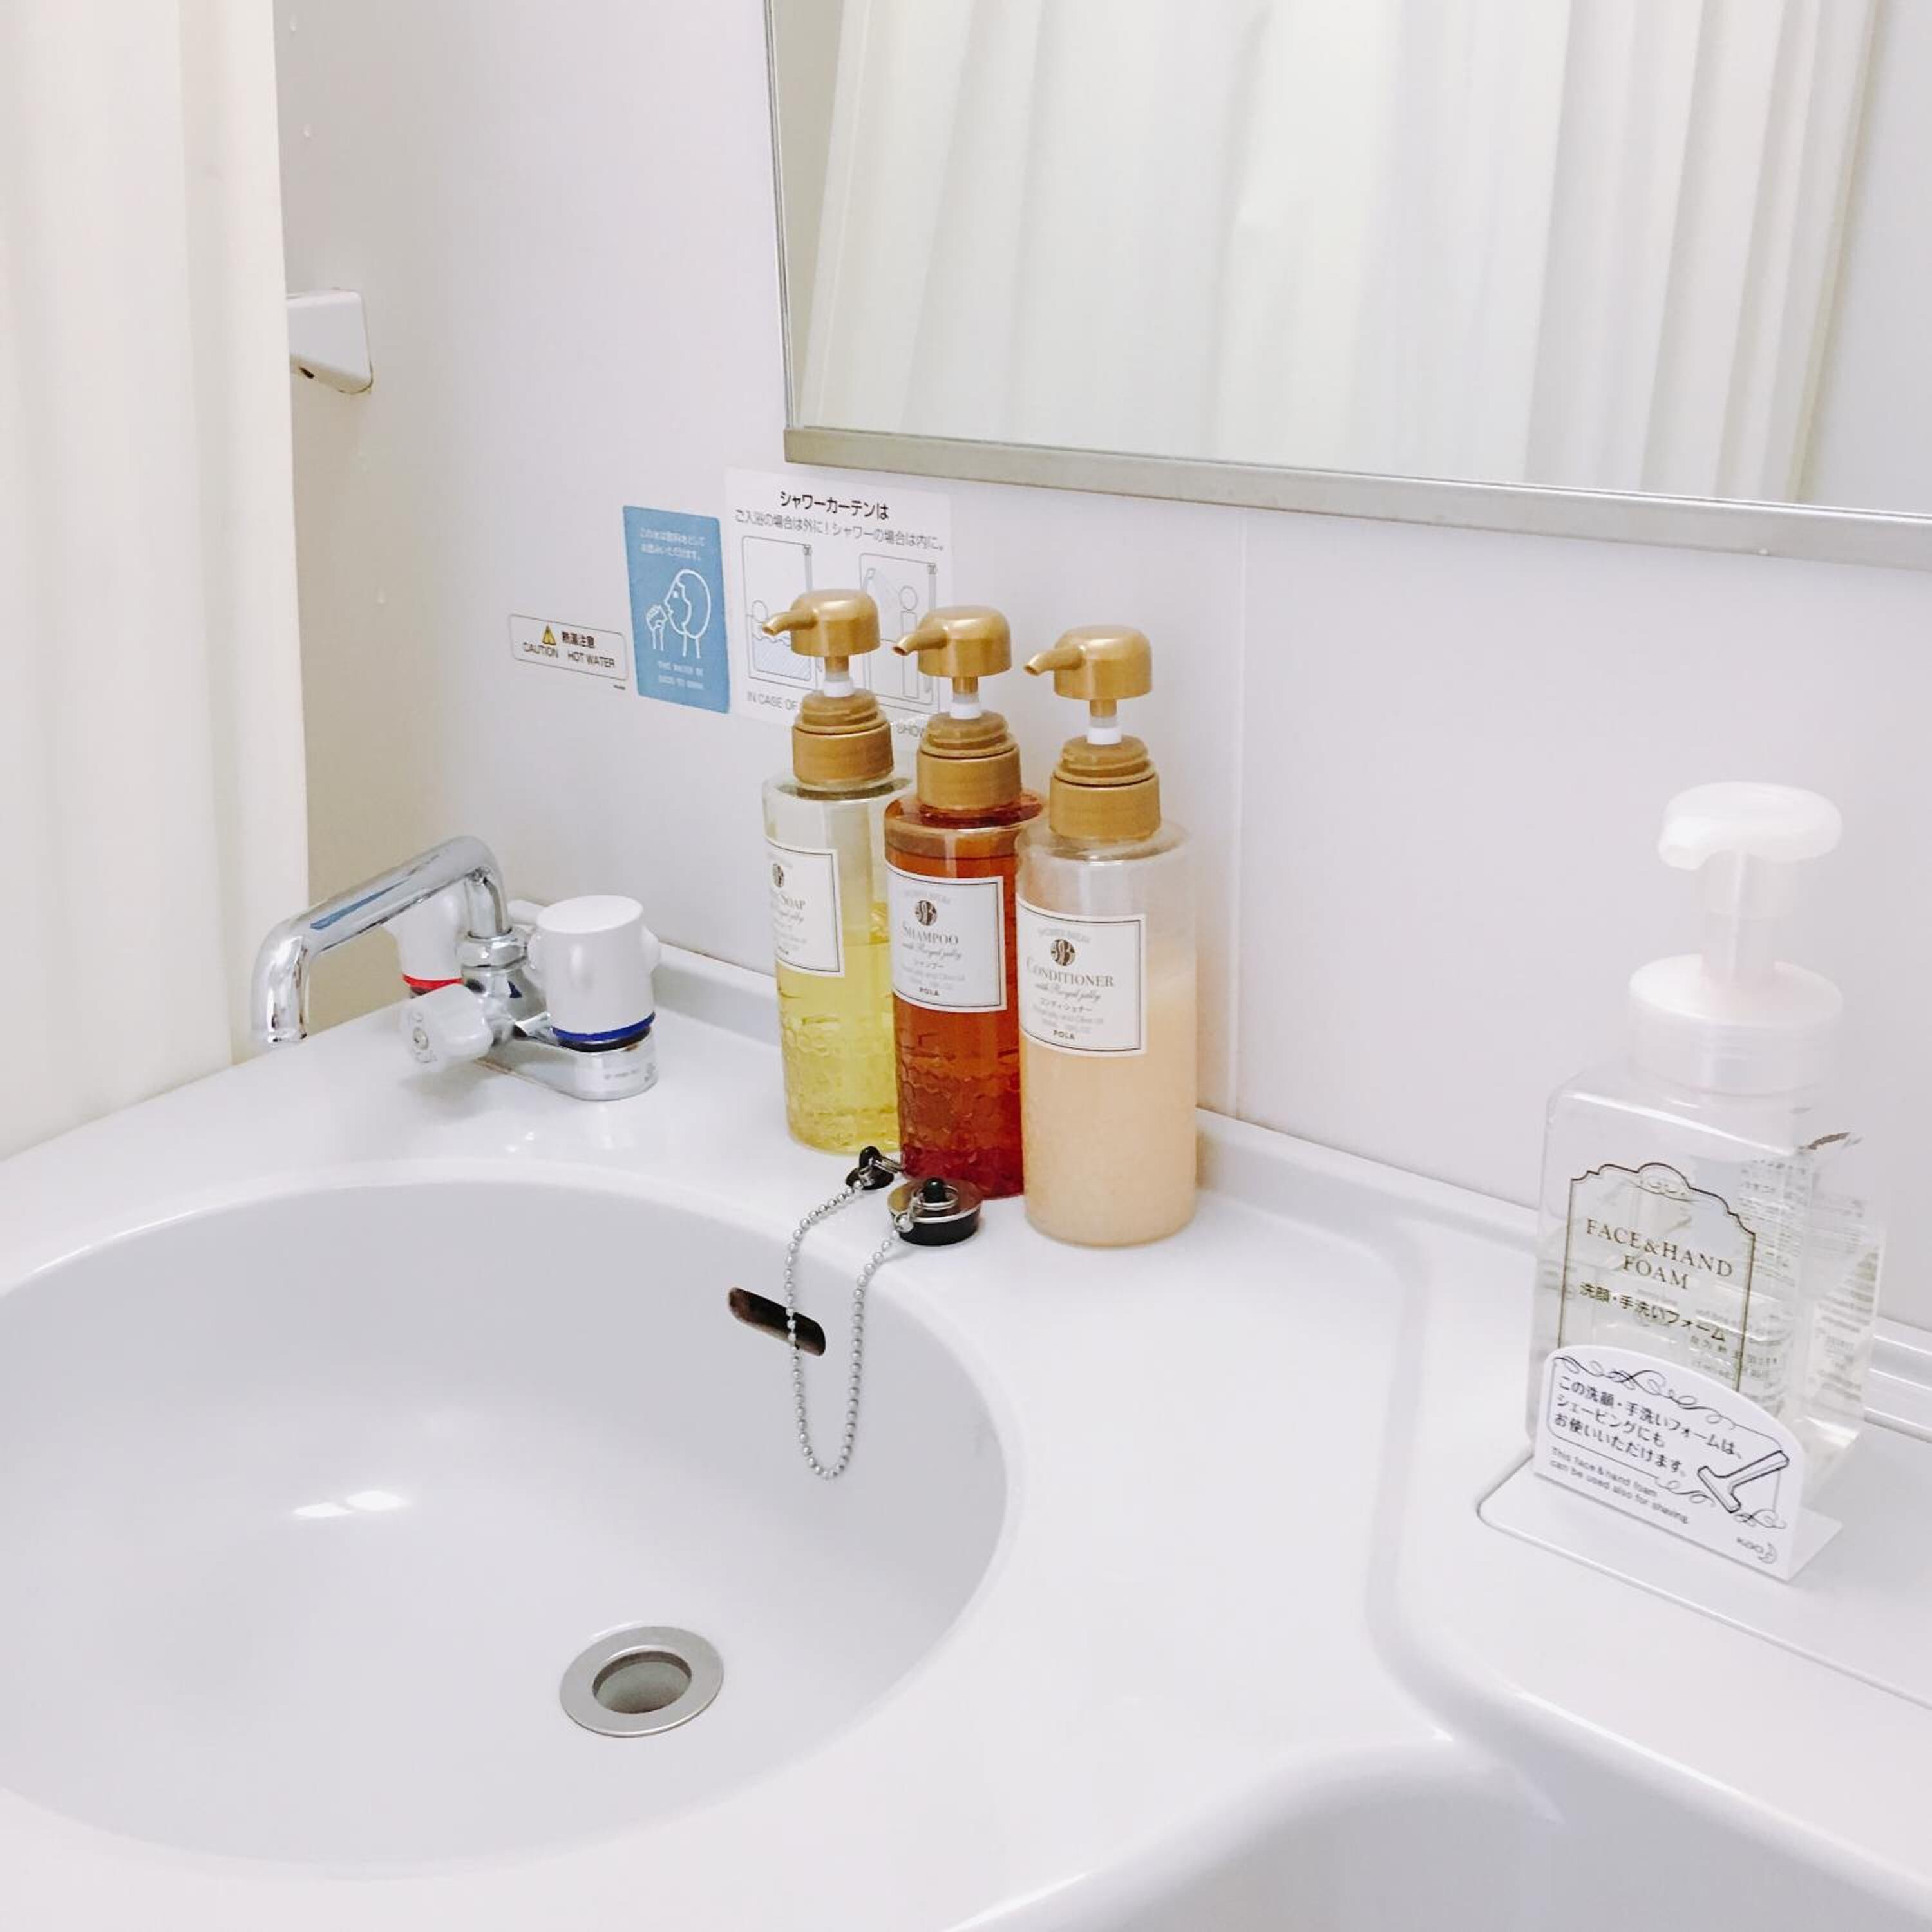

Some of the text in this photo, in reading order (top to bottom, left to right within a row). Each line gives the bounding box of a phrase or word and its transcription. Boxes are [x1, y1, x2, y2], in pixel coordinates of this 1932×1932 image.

[780, 491, 889, 520] シャワーカーテンは
[522, 641, 615, 668] CAUTION HOT WATER
[758, 694, 782, 710] CASE
[902, 920, 959, 945] SHAMPOO
[1027, 956, 1113, 988] CONDITIONER
[1053, 1030, 1075, 1040] POLA
[1622, 1254, 1688, 1289] FOAM
[1580, 1281, 1726, 1342] 洗顔・手洗いフォーム
[1555, 1393, 1666, 1450] シェービングにも
[1551, 1446, 1571, 1462] This
[1554, 1412, 1687, 1478] お使いいただけます。
[1549, 1459, 1569, 1472] can
[1570, 1466, 1584, 1478] be
[1586, 1475, 1610, 1490] used
[1612, 1484, 1633, 1499] also
[1635, 1493, 1649, 1505] for
